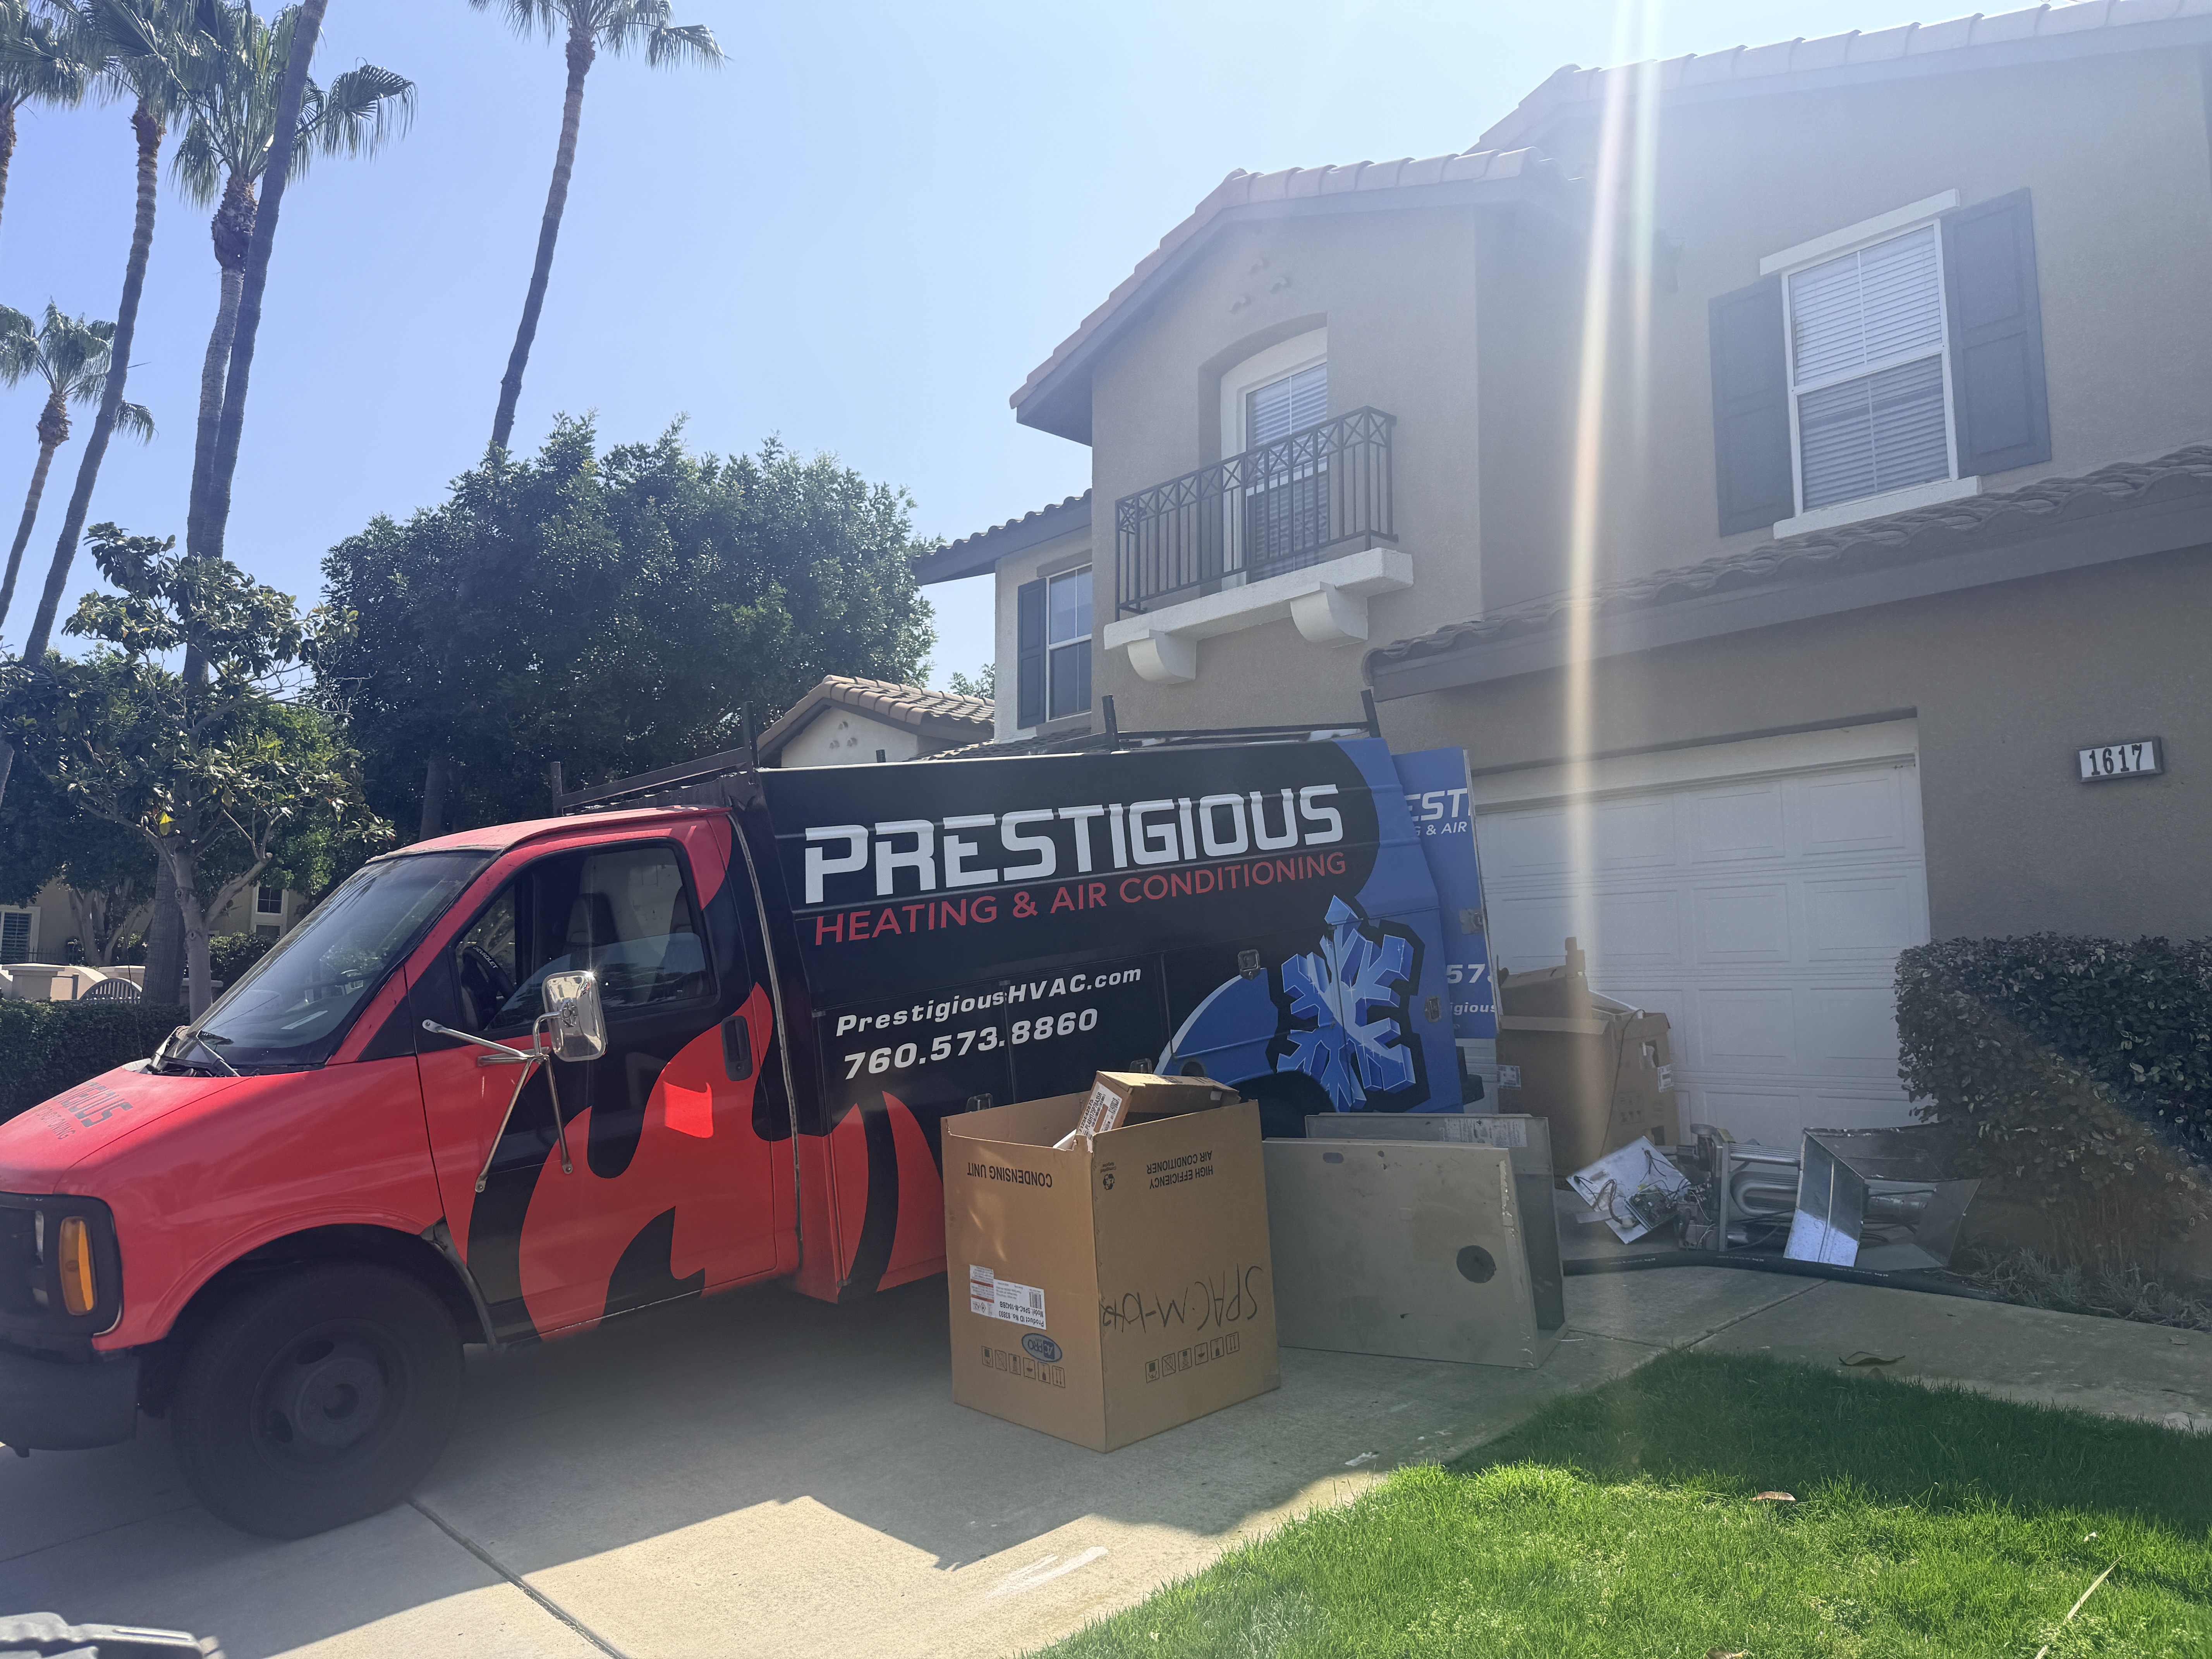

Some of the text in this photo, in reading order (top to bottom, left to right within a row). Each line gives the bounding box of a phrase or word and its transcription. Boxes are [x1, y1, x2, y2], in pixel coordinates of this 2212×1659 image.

[2089, 744, 2142, 776] 1617
[1426, 824, 1436, 835] &
[1441, 821, 1467, 834] AIR
[805, 784, 1343, 904] PRESTIGIOUS
[814, 852, 1346, 946] HEATING & AIR CONDITIONING
[473, 946, 498, 968] CHEVROLET
[835, 968, 1141, 1037] PrestigiousHVAC.com
[844, 1008, 1098, 1080] 760.573.8860
[1147, 1150, 1212, 1174] AIR CONDITIONER
[967, 1163, 1052, 1188] CONDENSING UNIT
[1149, 1165, 1213, 1190] HIGH EFFICIENCY
[1026, 1317, 1044, 1327] Product
[1032, 1309, 1044, 1318] Model:
[1028, 1340, 1053, 1355] AC PRO
